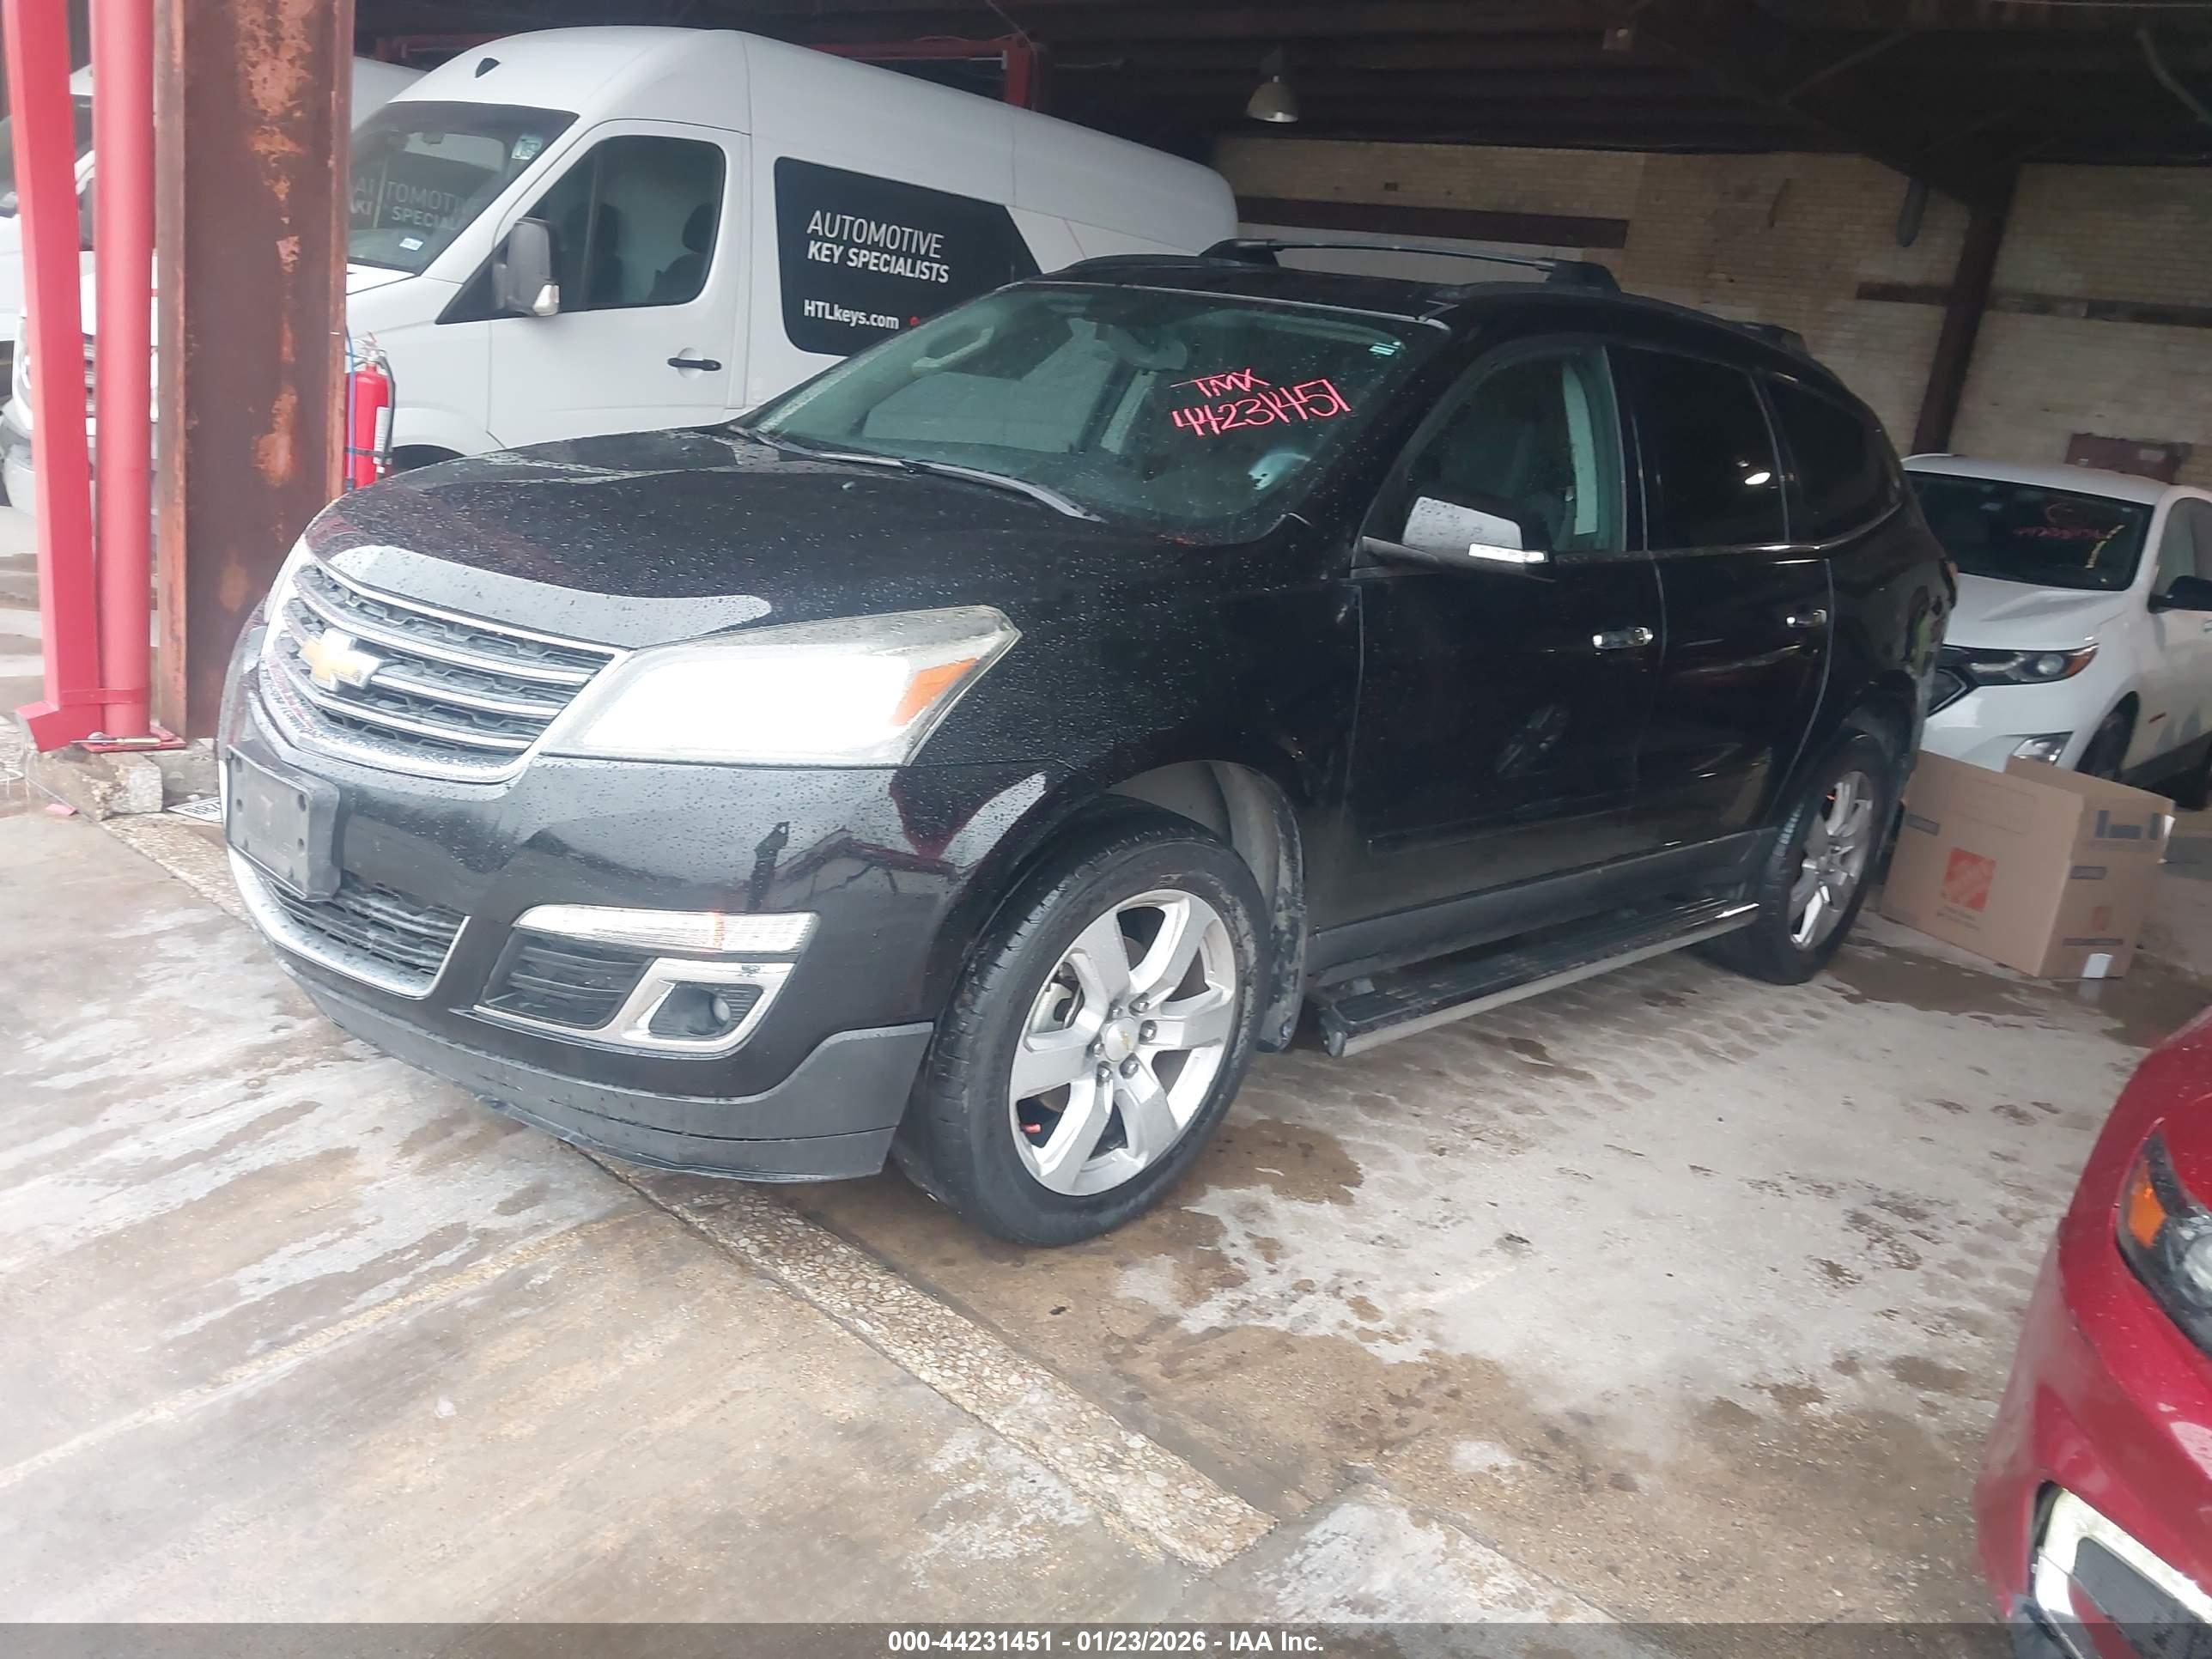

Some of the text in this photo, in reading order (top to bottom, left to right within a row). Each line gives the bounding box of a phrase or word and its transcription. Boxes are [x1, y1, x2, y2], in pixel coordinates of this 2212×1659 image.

[806, 210, 945, 258] AUTOMOTIVE
[807, 240, 950, 283] KEY SPECIALISTS
[804, 300, 899, 330] HTLkeys.com
[1170, 368, 1271, 398] TMX
[1172, 379, 1352, 436] 44231451
